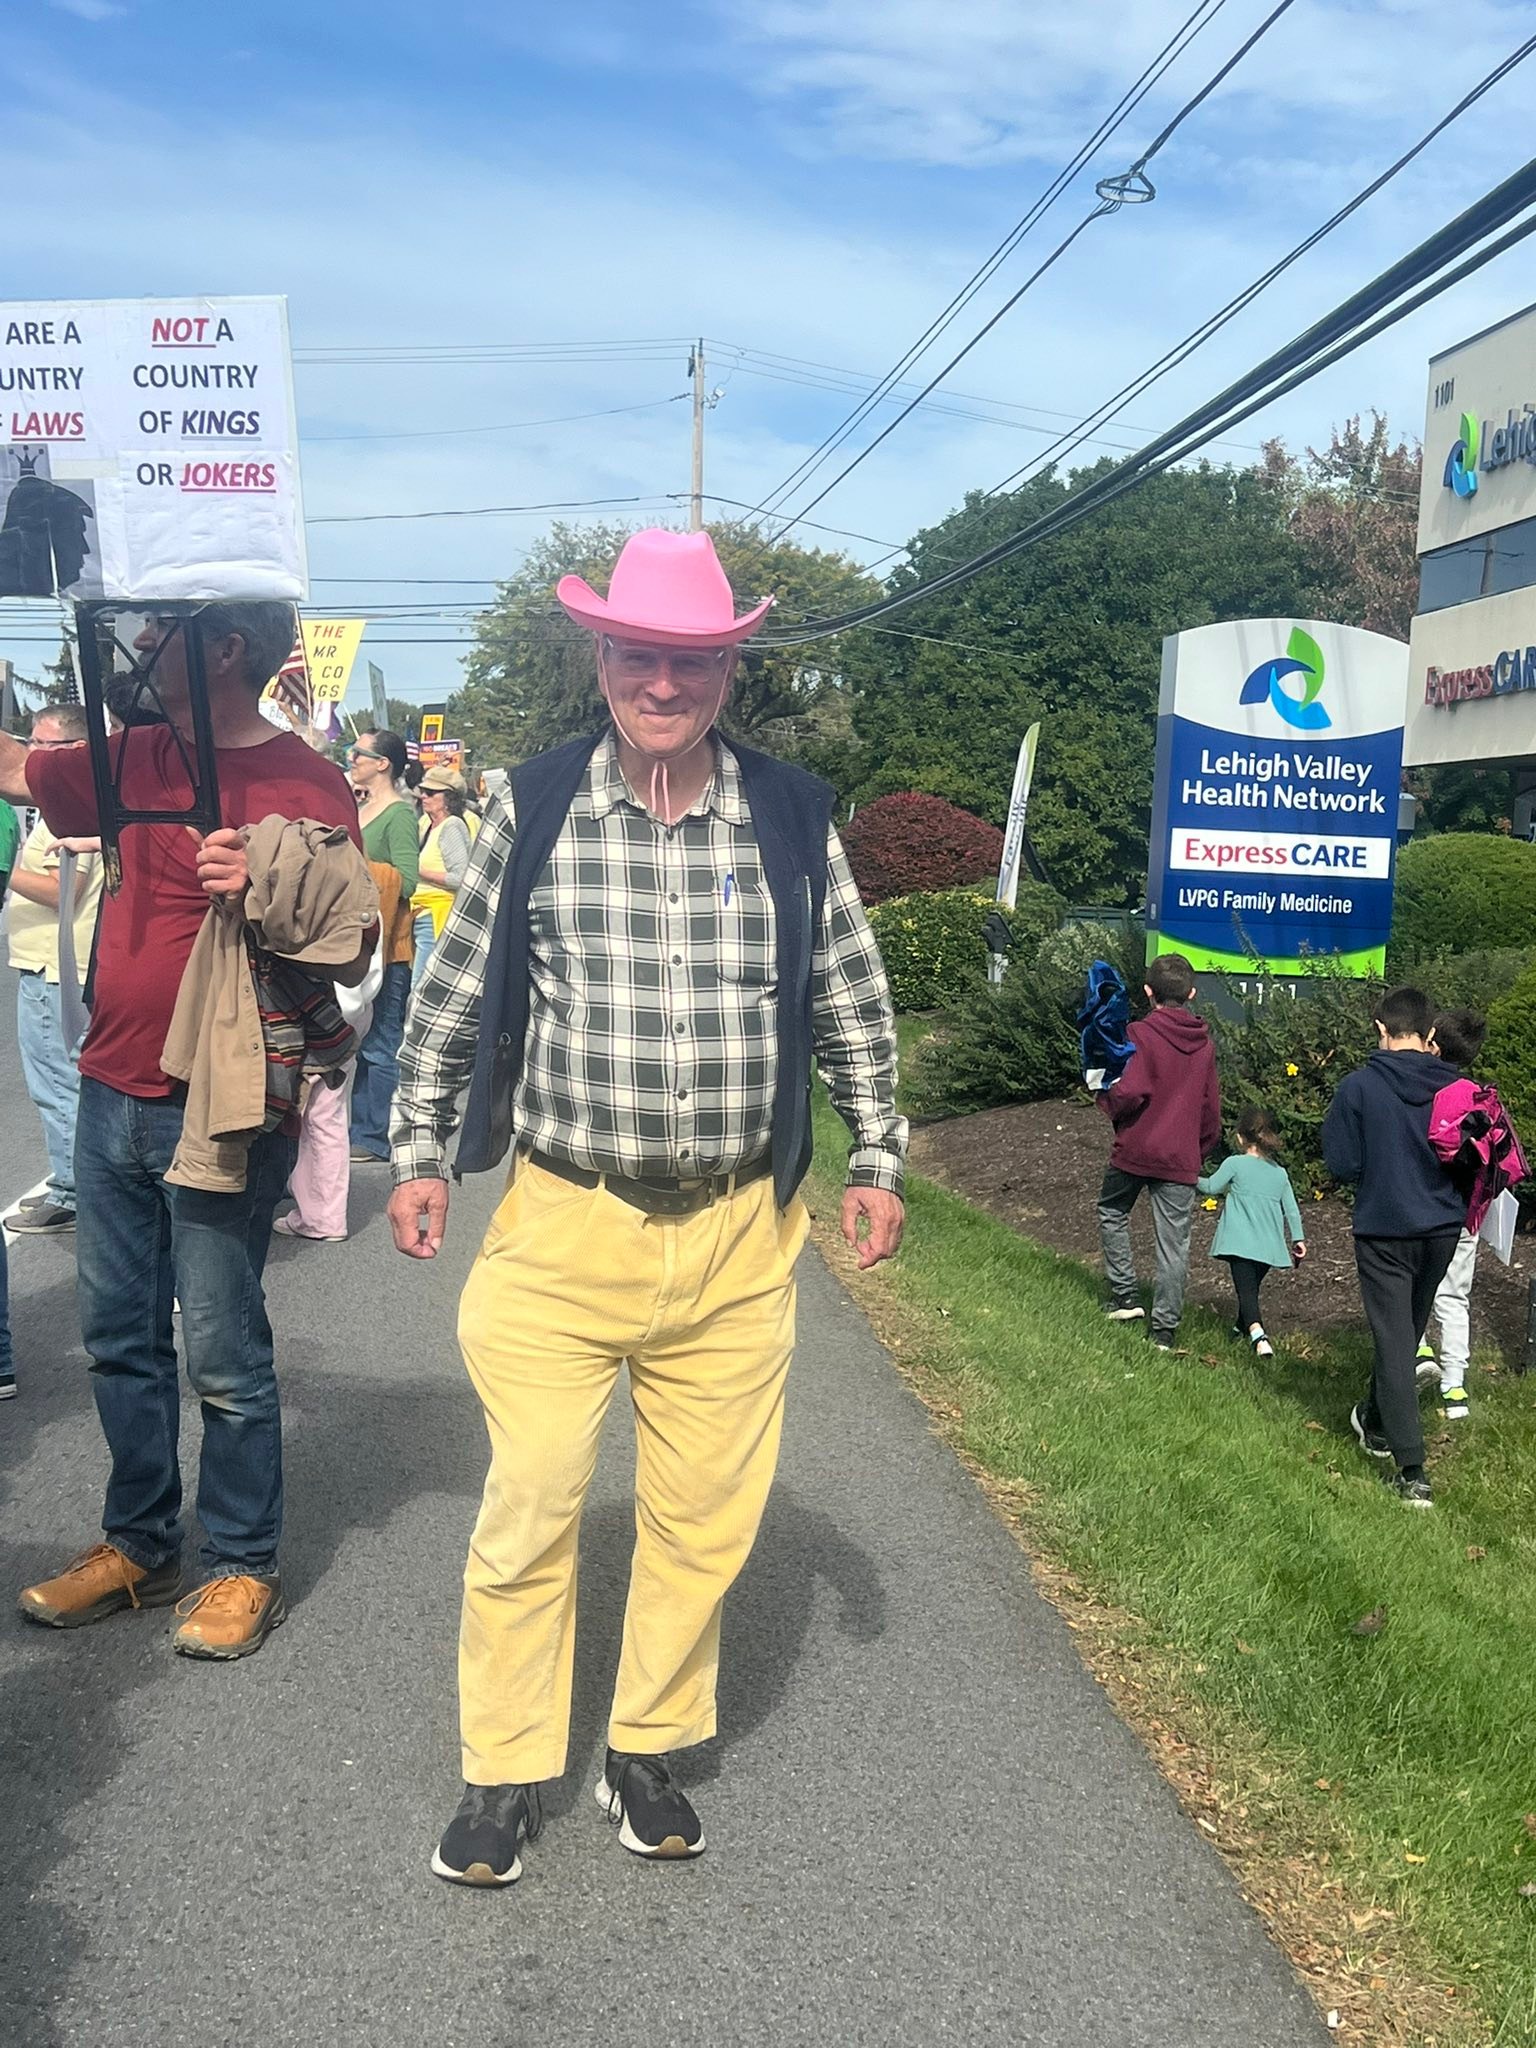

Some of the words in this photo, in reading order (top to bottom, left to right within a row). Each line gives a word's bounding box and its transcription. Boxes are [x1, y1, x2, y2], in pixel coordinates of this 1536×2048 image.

[5, 321, 56, 345] ARE
[63, 321, 82, 345] A
[152, 317, 210, 343] NOT
[215, 318, 235, 342] A
[133, 364, 259, 389] COUNTRY
[1435, 377, 1455, 409] 1101
[11, 411, 85, 436] LAWS
[139, 410, 173, 434] OF
[181, 410, 260, 435] KINGS
[136, 462, 174, 486] OR
[180, 462, 276, 487] JOKERS
[313, 625, 346, 639] THE
[313, 645, 338, 659] MR
[322, 665, 345, 679] CO
[312, 684, 341, 698] GS
[1201, 749, 1290, 782] Lehigh
[1293, 753, 1373, 788] Valley
[1182, 779, 1268, 808] Health
[1273, 784, 1386, 814] Network
[1179, 888, 1219, 908] LVPG
[1222, 890, 1276, 914] Family
[1280, 892, 1353, 914] Medicine
